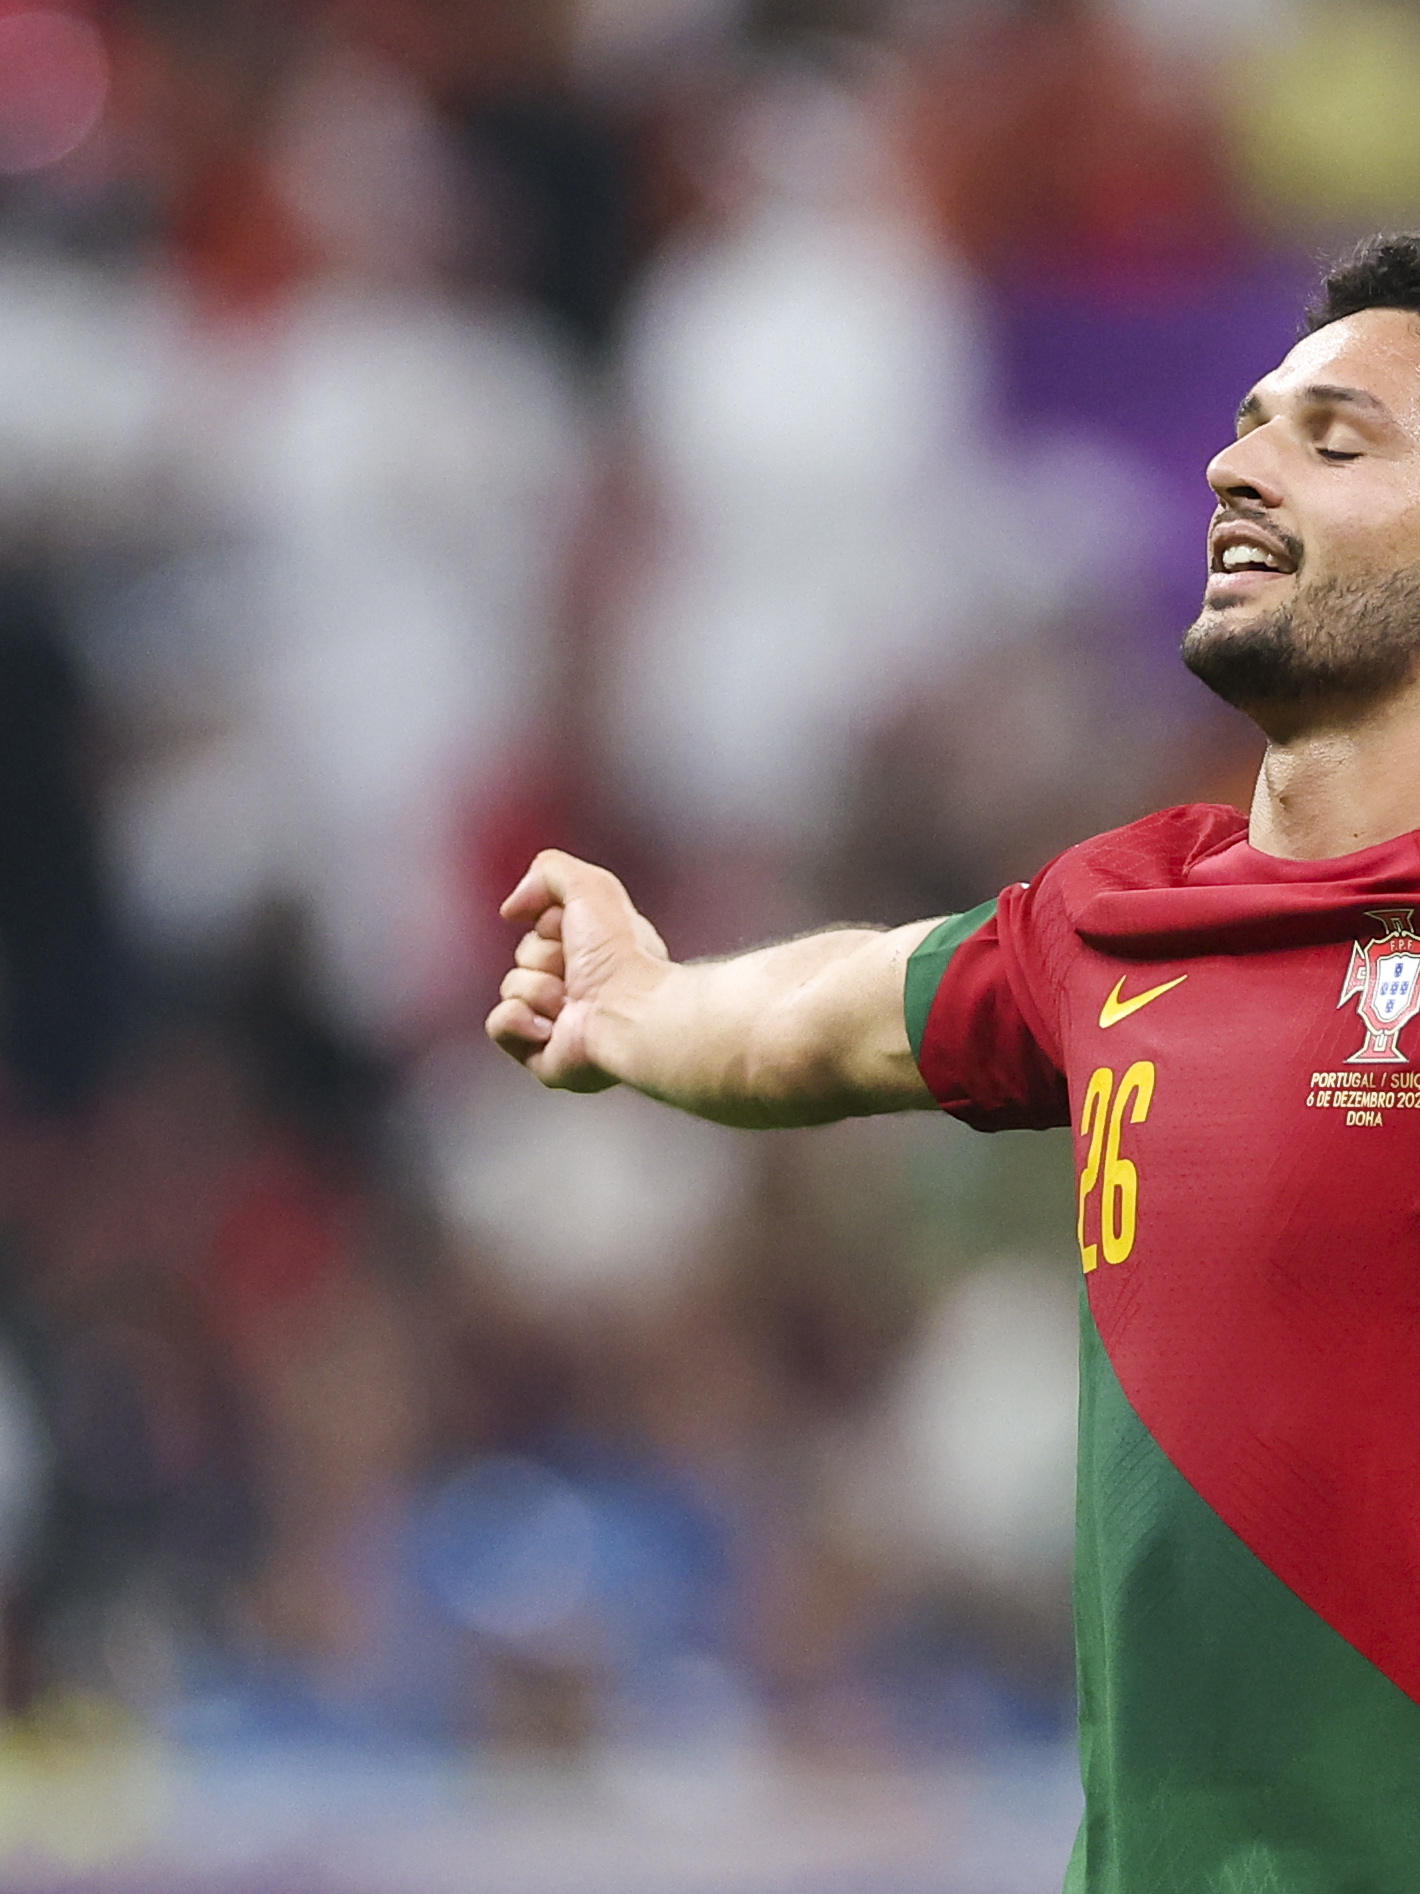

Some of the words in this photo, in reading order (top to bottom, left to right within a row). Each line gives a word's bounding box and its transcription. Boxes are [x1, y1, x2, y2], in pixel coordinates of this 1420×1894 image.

[1310, 1072, 1376, 1088] PORTUGAL
[1380, 1072, 1388, 1087] /
[1306, 1091, 1314, 1107] 6
[1316, 1091, 1332, 1107] DE
[1333, 1091, 1395, 1108] DEZEMBRO
[1345, 1110, 1383, 1126] DOHA
[1078, 1061, 1155, 1274] 26
